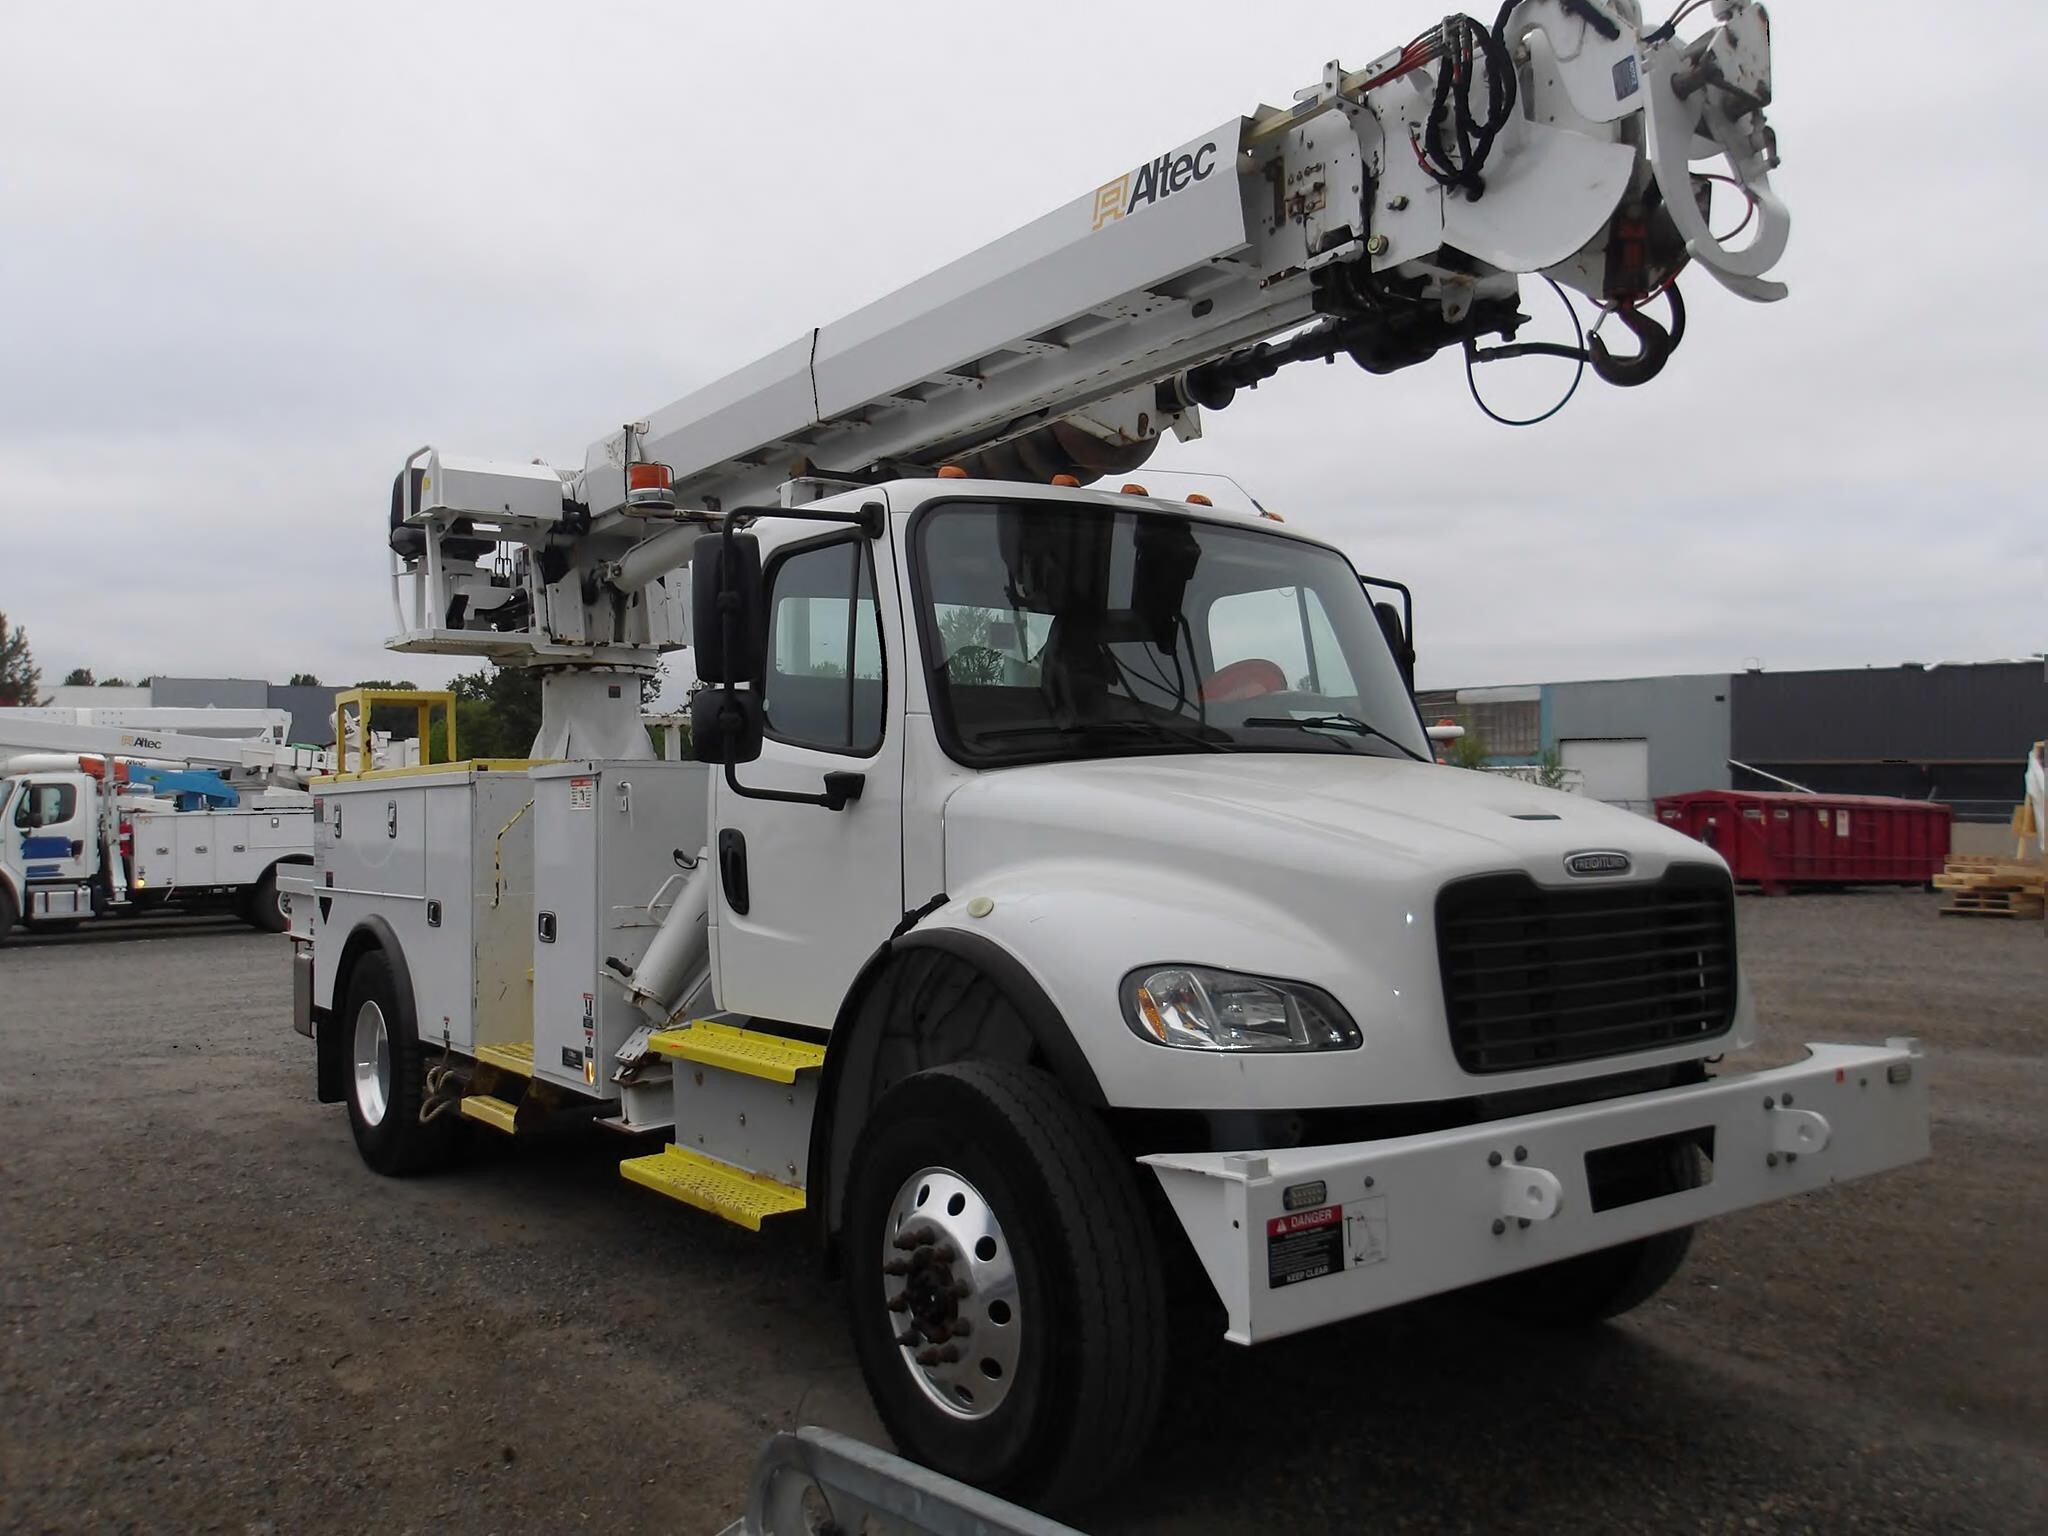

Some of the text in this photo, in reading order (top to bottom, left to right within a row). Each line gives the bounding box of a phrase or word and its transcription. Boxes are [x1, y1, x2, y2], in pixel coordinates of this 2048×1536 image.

[1126, 142, 1217, 216] Altec
[134, 737, 162, 749] Altec
[1291, 1209, 1332, 1227] DANGER
[1305, 1265, 1329, 1278] CLEAR
